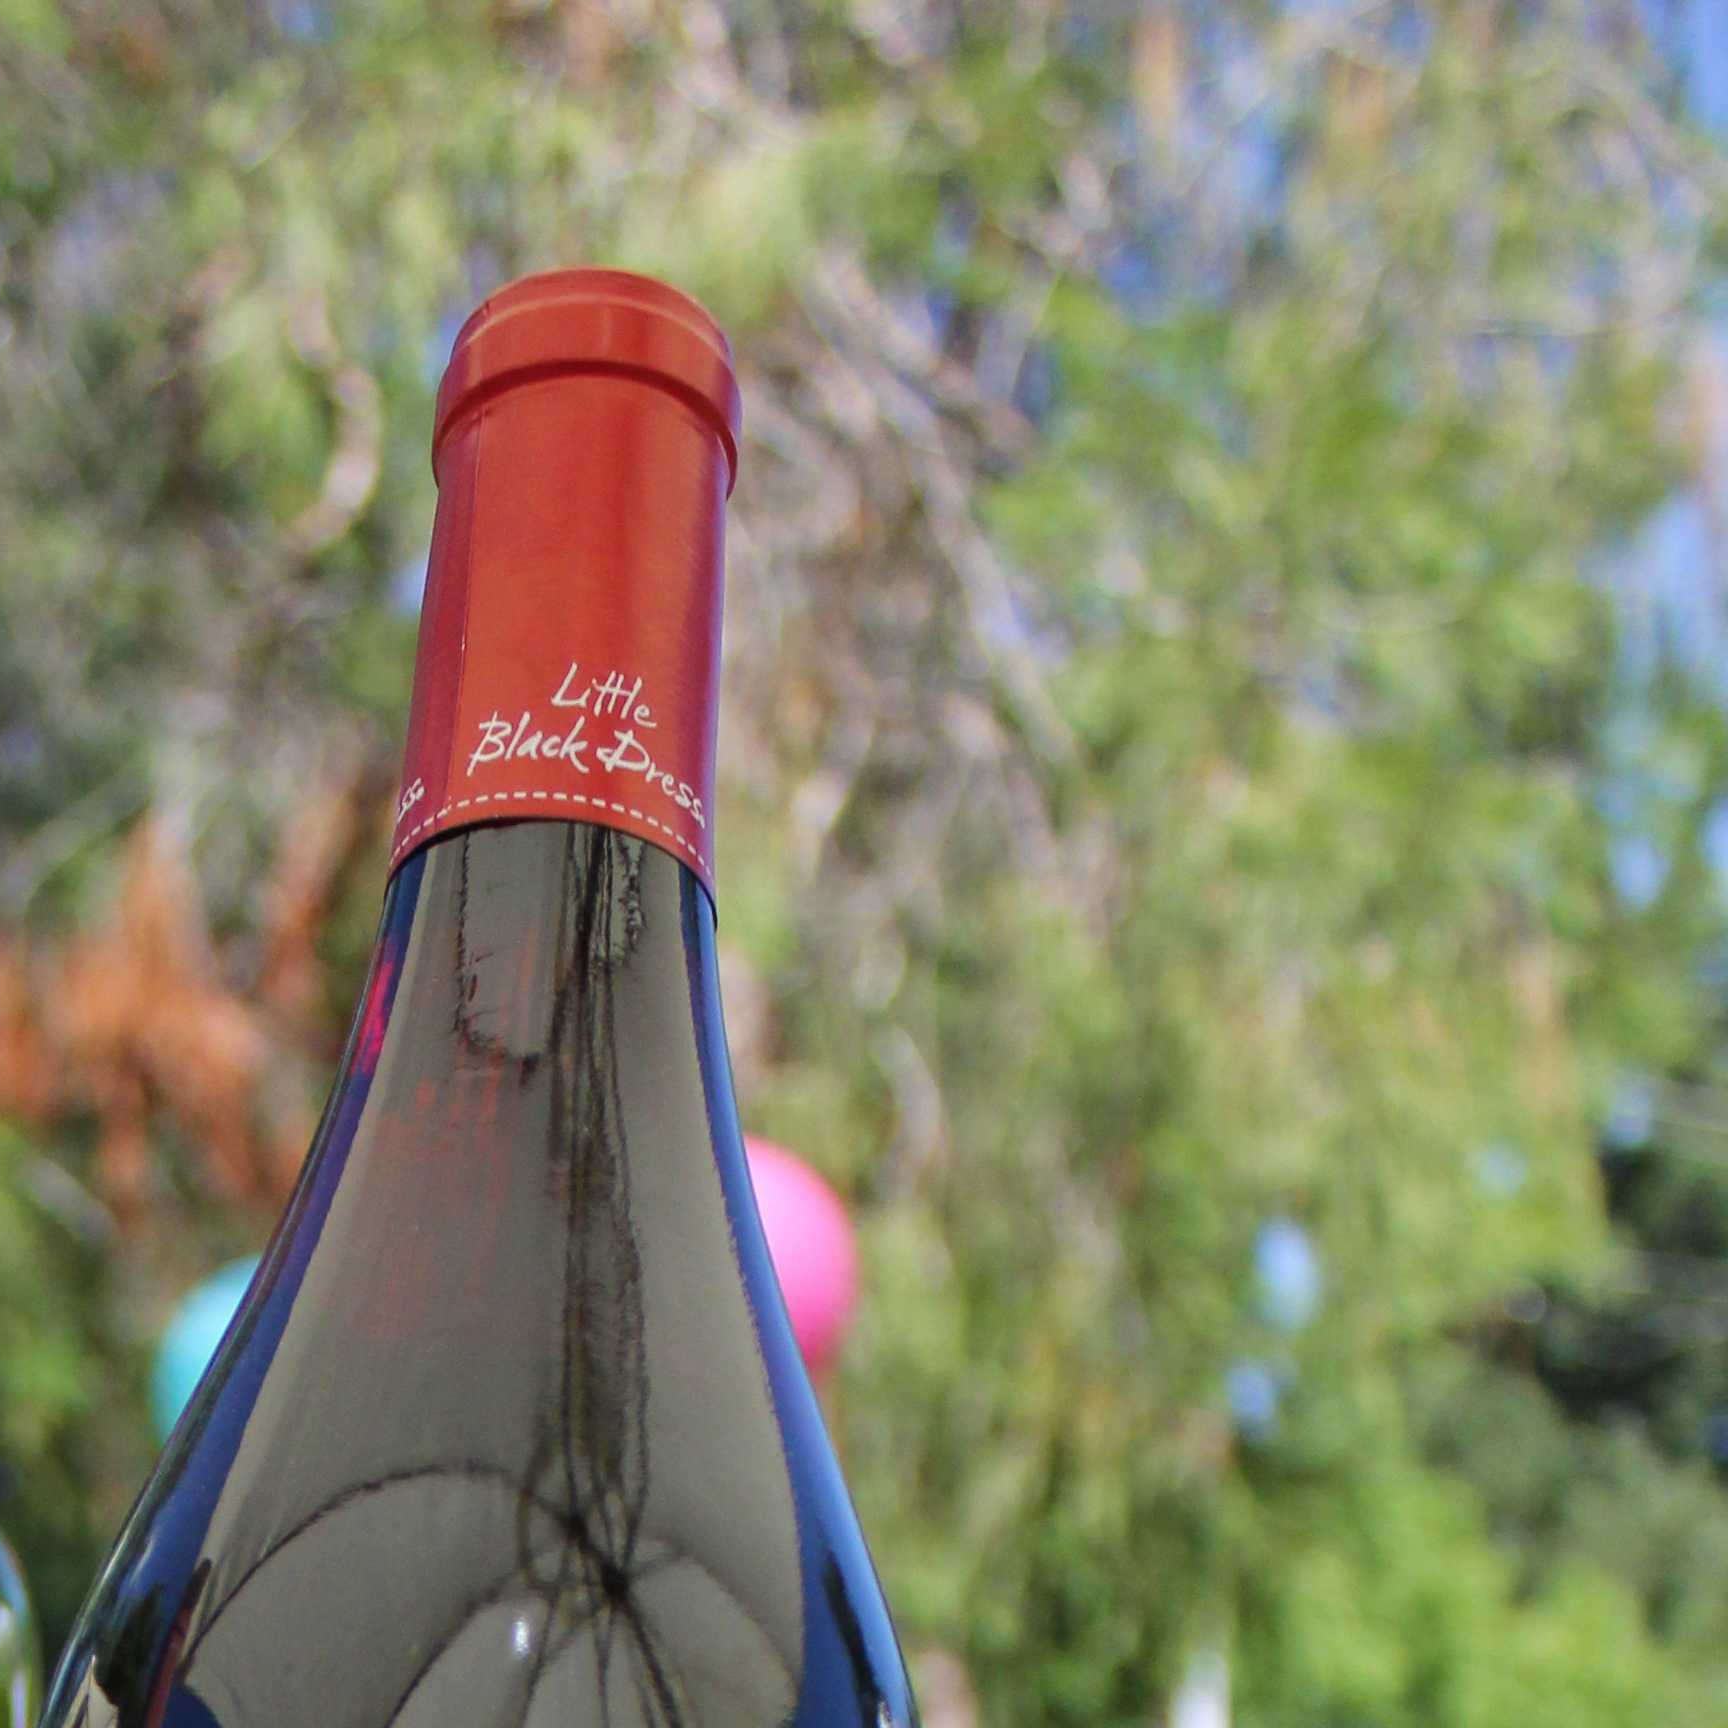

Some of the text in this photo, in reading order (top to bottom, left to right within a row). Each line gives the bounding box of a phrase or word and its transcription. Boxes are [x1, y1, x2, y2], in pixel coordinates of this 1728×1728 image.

[551, 661, 658, 728] Little
[466, 710, 704, 826] Black Dress
